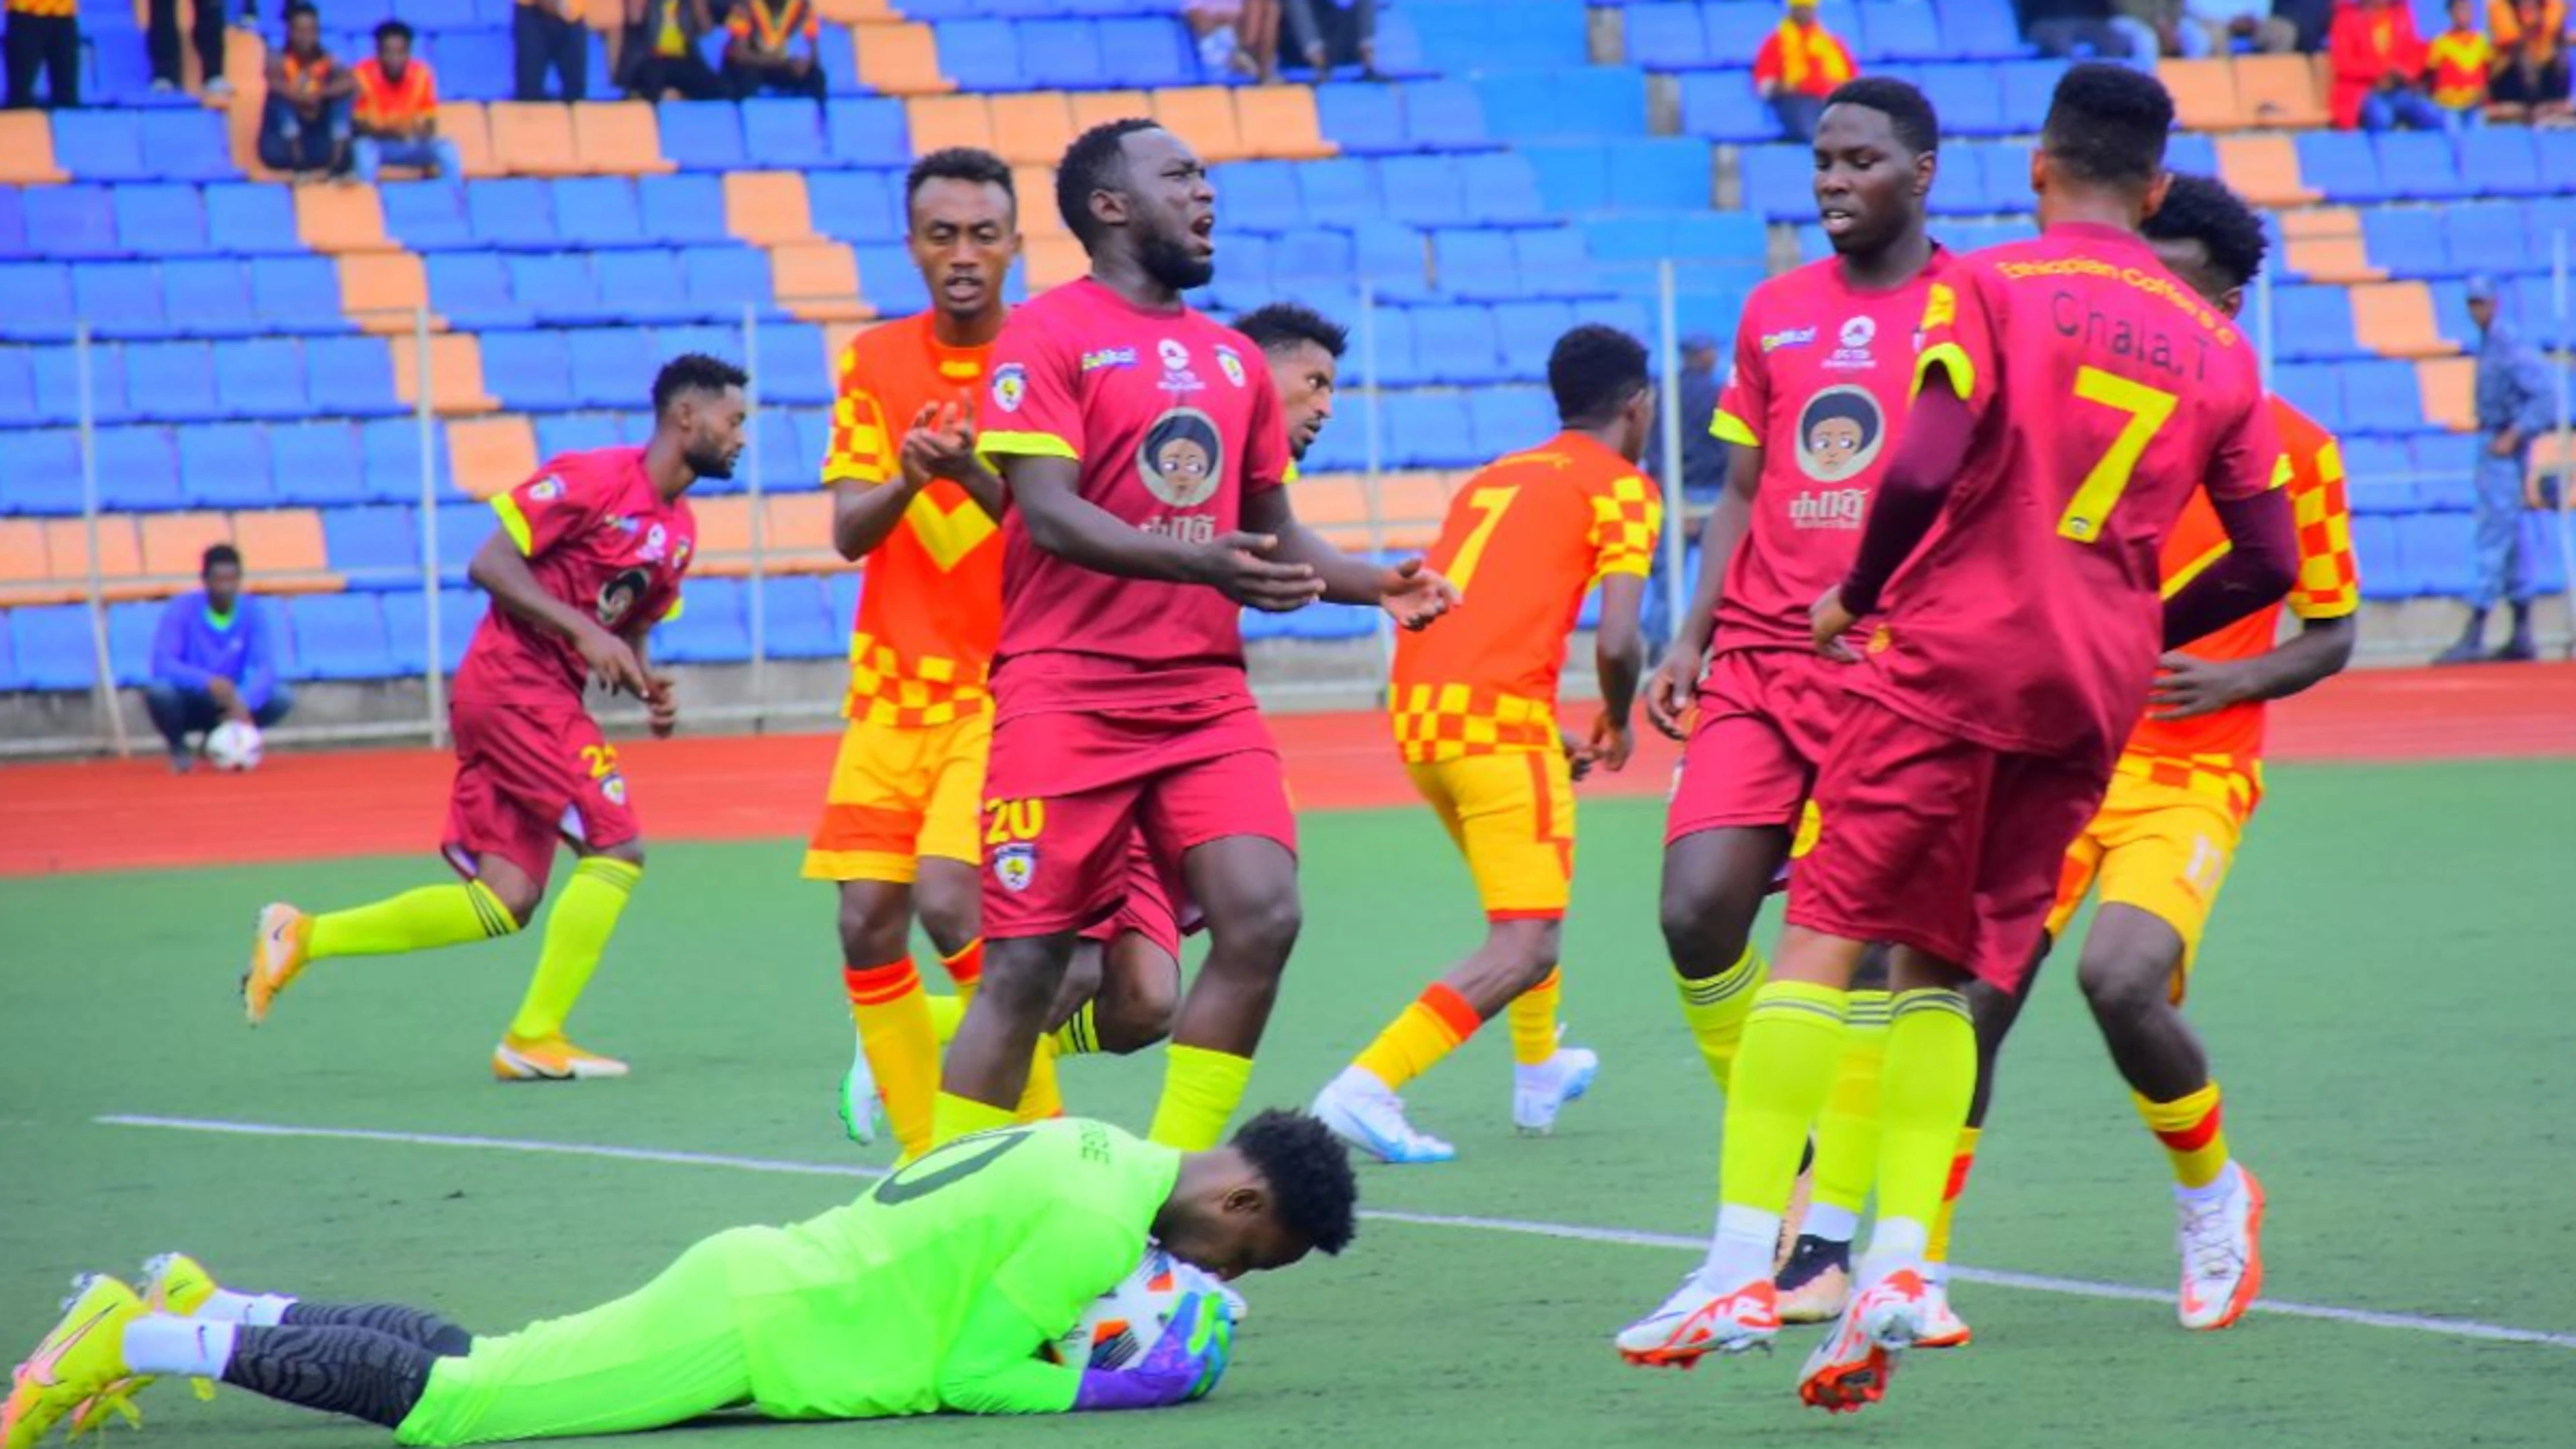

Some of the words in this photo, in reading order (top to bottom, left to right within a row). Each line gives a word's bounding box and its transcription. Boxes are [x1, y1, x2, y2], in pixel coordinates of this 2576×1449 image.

[2121, 268, 2198, 317] Coffee
[2056, 365, 2180, 544] 7
[1441, 484, 1521, 594] 7
[985, 798, 1045, 845] 20
